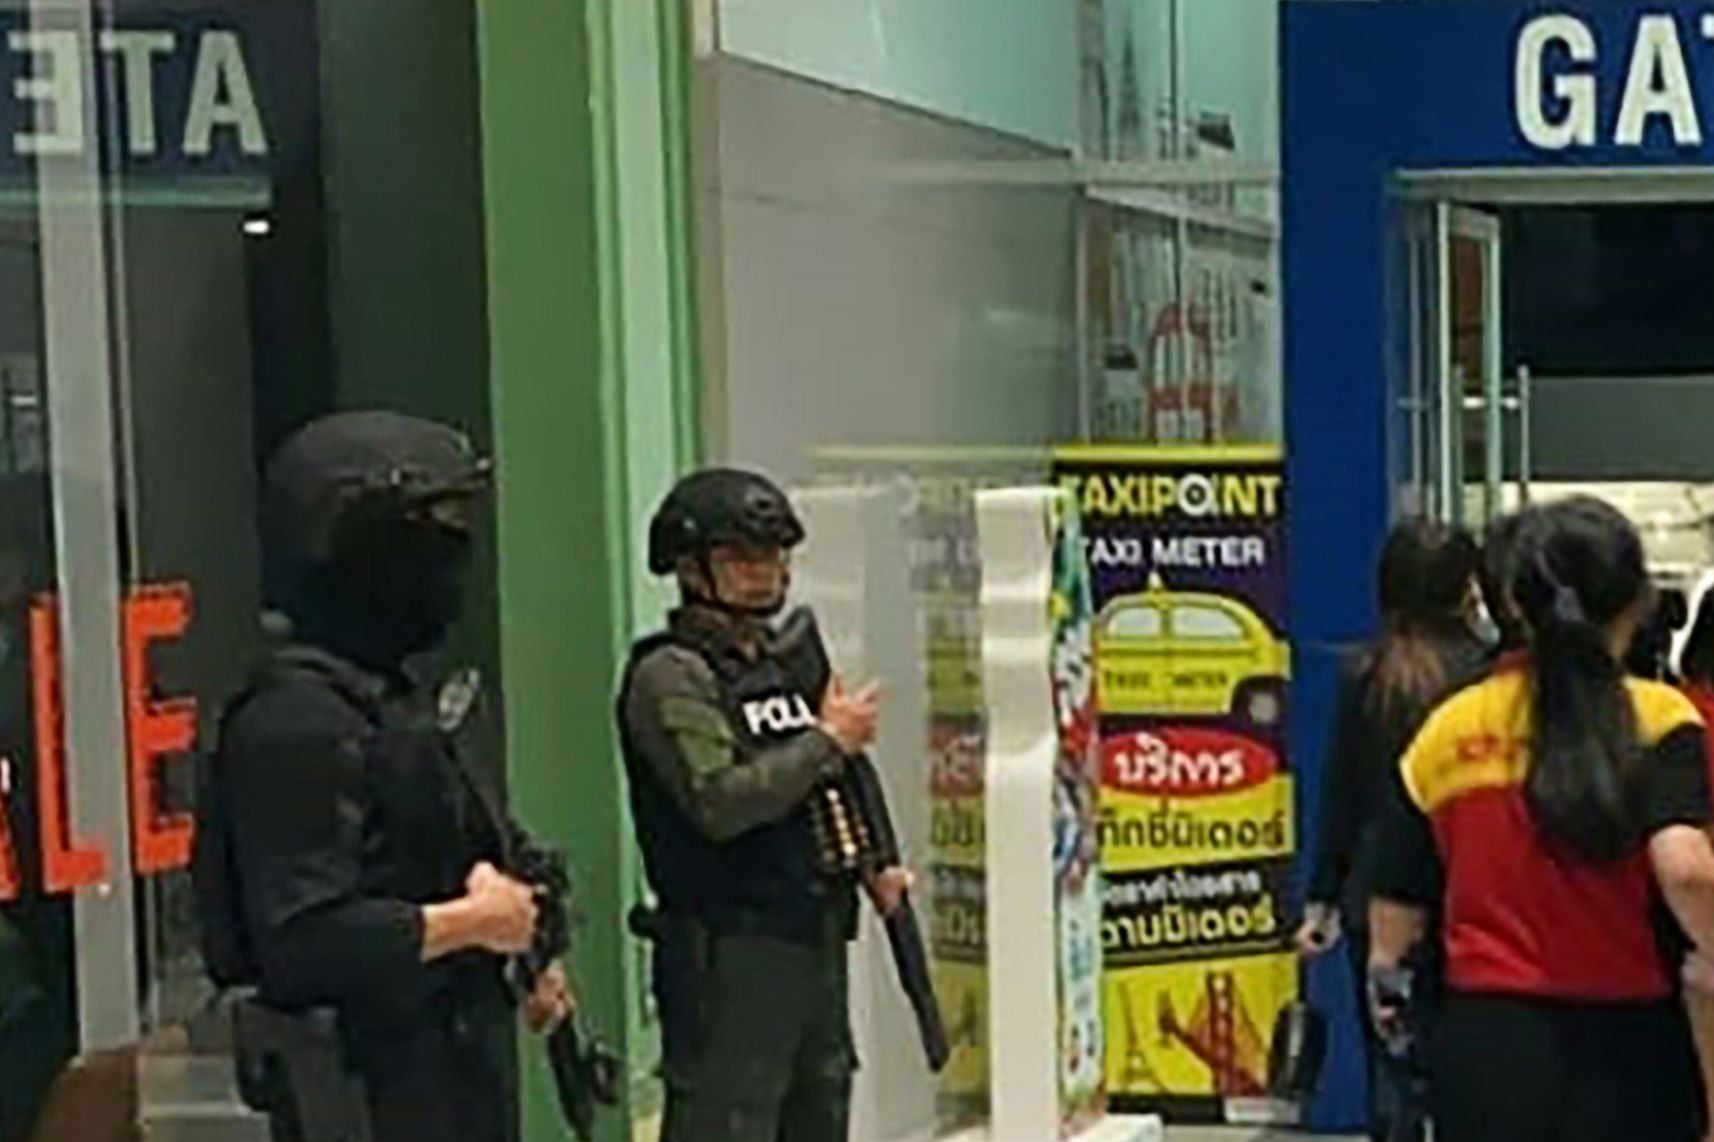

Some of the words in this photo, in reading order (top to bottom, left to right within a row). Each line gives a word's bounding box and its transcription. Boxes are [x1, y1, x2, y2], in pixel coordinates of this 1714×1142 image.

[1080, 536, 1141, 565] AXI
[1152, 534, 1266, 566] METER
[0, 580, 199, 898] LE
[1114, 730, 1244, 786] บริการ
[1097, 798, 1284, 849] ท็กซี่มิเตอร์
